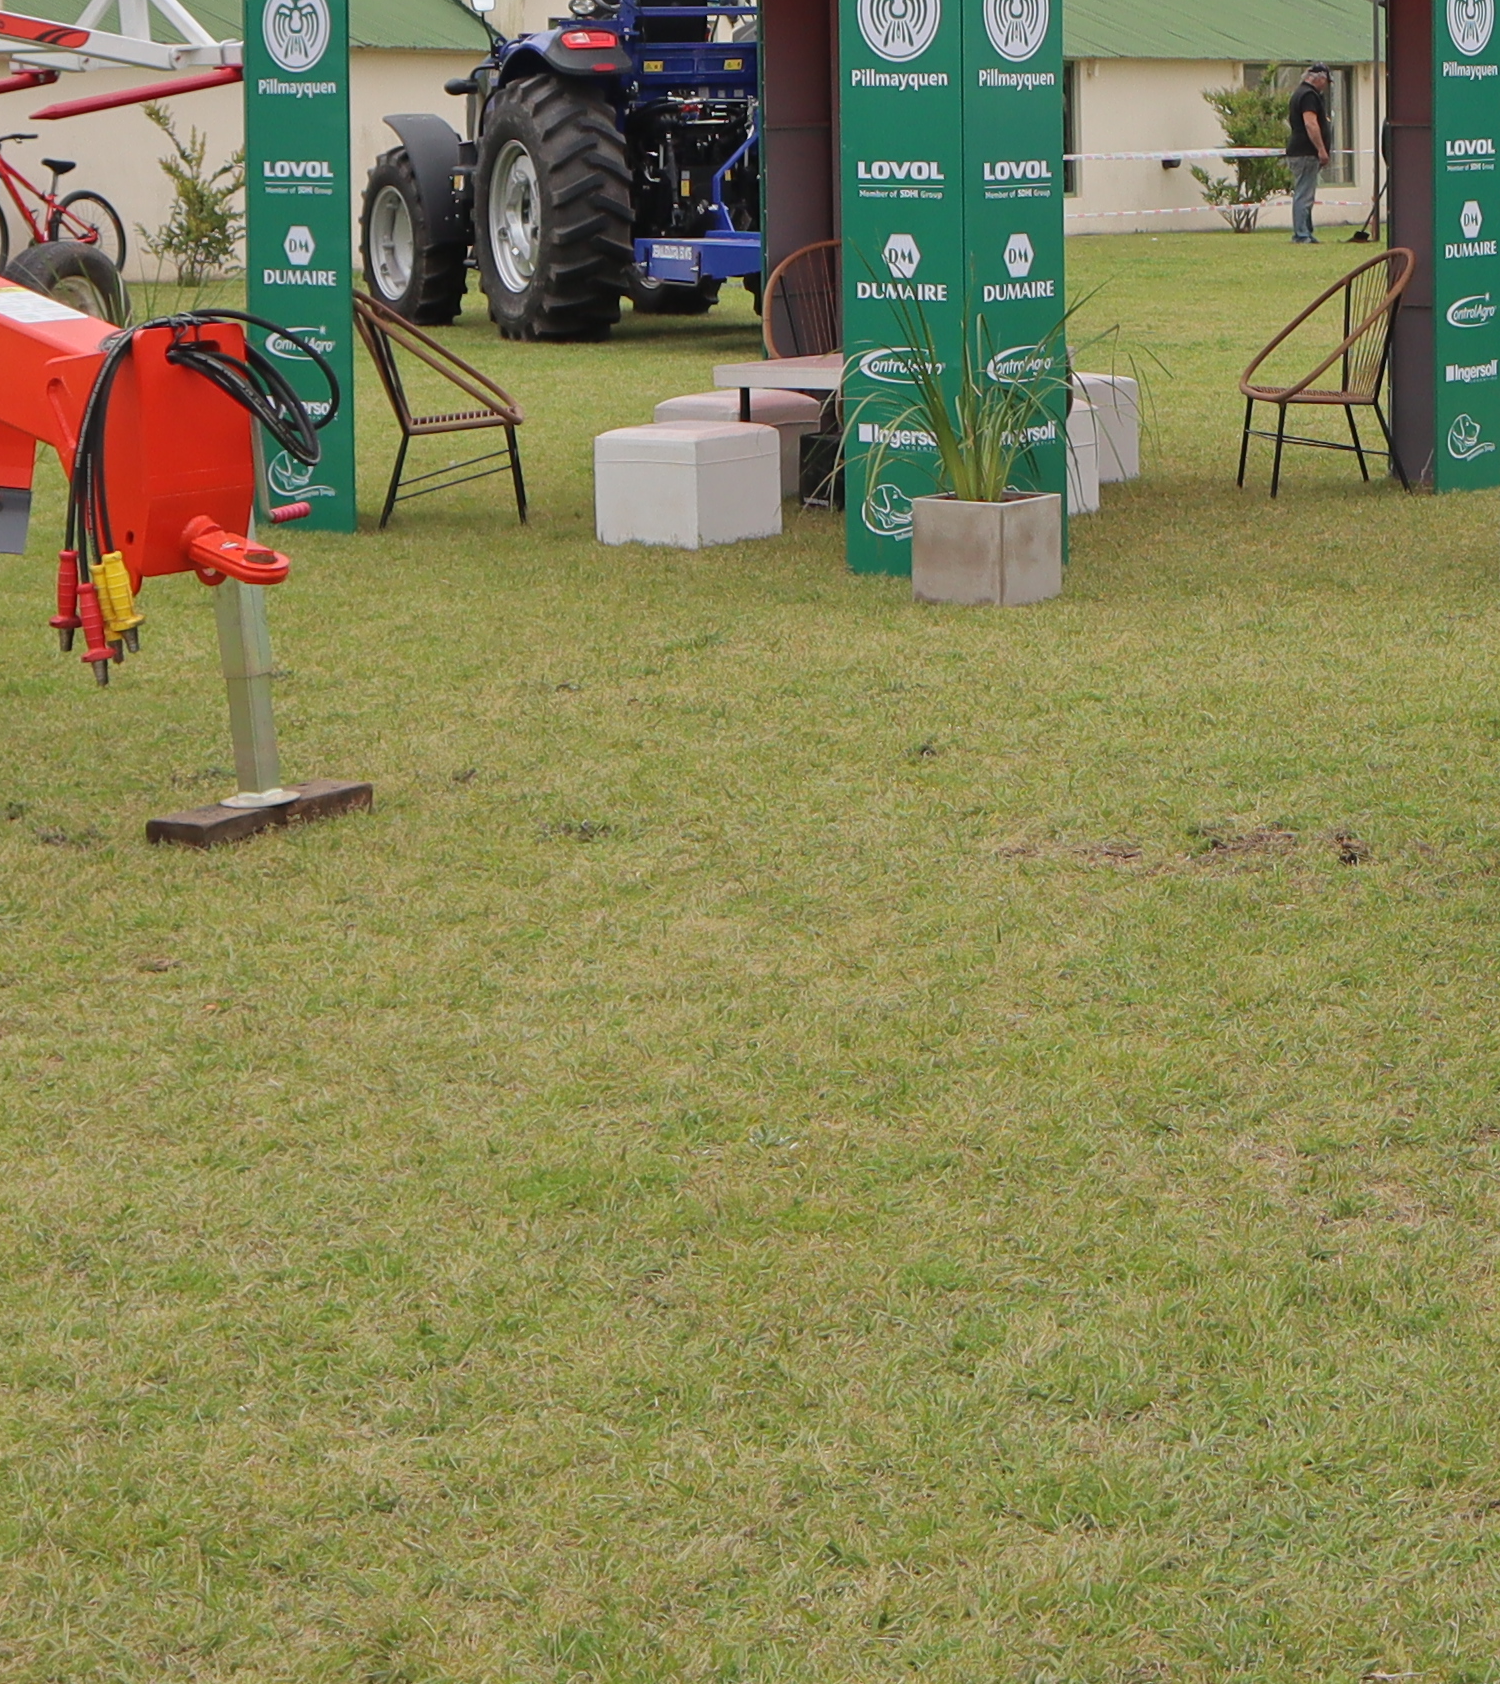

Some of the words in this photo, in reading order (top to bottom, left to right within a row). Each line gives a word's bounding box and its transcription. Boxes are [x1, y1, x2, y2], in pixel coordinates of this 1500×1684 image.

[851, 68, 948, 91] Pillmayquen
[978, 68, 1055, 91] Pillmayquen
[1443, 61, 1498, 81] Pillmayquen
[258, 78, 337, 99] Pillmayquen
[1445, 138, 1496, 157] LOVOL
[263, 161, 334, 178] LOVOL
[857, 161, 945, 180] LOVOL
[983, 160, 1052, 182] LOVOL
[1463, 213, 1478, 227] DM
[288, 238, 310, 254] DM
[889, 247, 914, 265] DM
[1008, 247, 1029, 265] DM
[1445, 240, 1497, 260] DUMAIRE
[263, 269, 337, 287] DUMAIRE
[856, 281, 948, 302] DUMAIRE
[983, 280, 1055, 303] DUMAIRE
[1446, 295, 1496, 328] ControlAgro
[1455, 359, 1499, 383] Ingersoll
